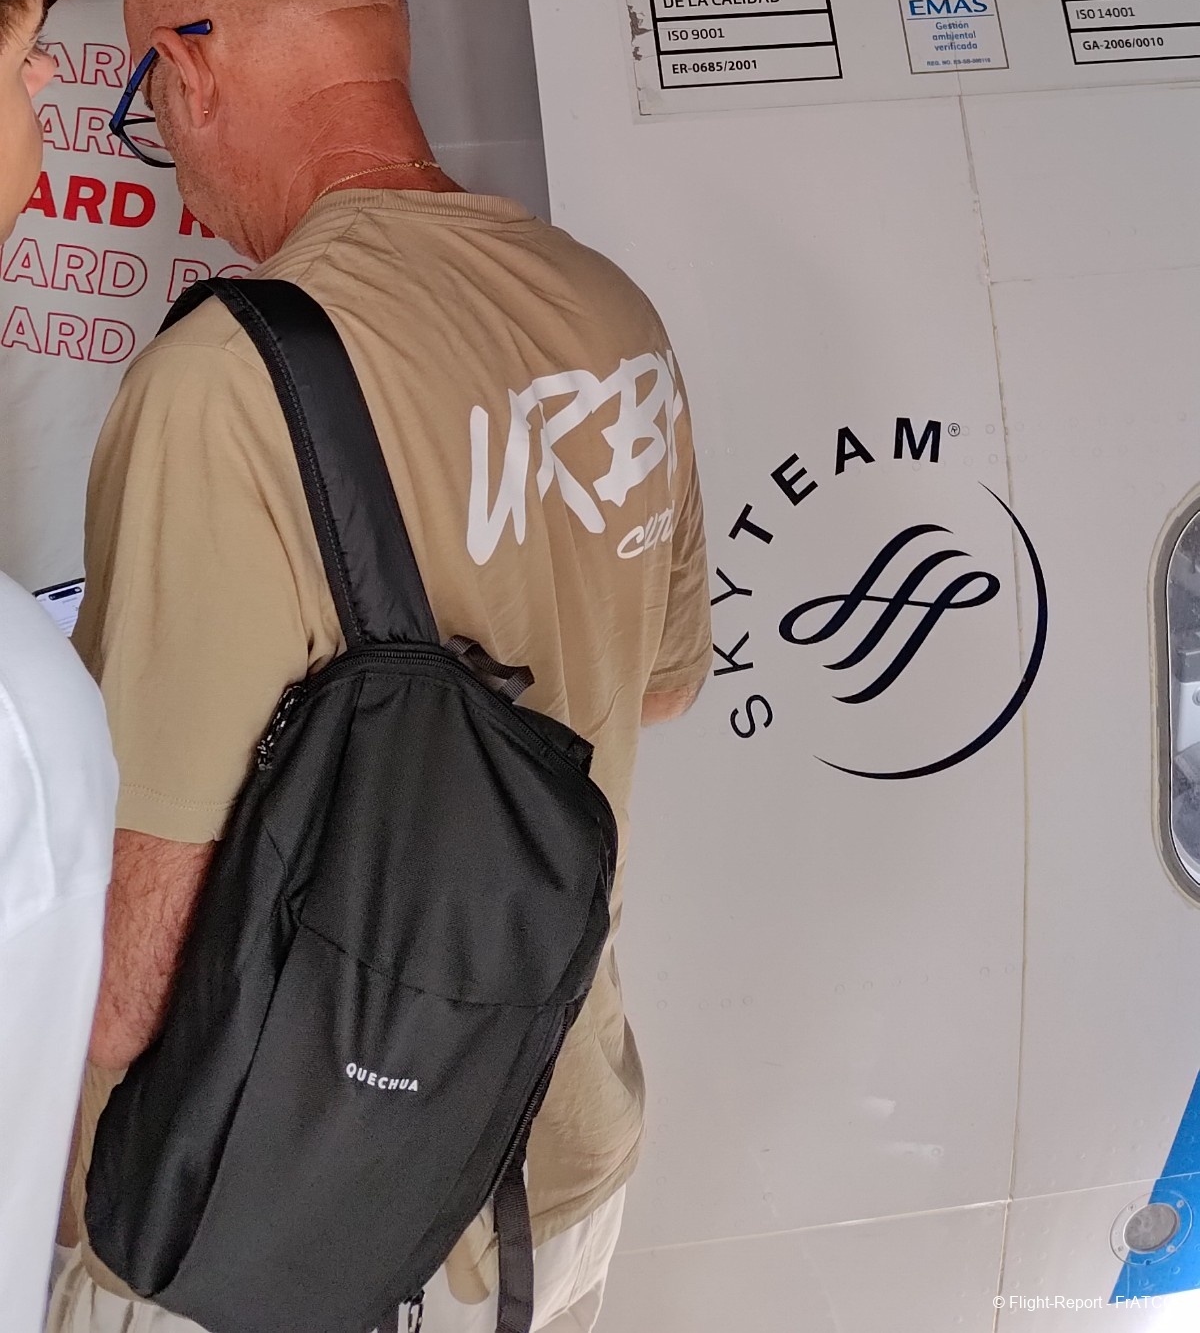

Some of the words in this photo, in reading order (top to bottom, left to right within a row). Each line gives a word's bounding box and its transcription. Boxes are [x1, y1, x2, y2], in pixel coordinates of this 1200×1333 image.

[1076, 8, 1096, 20] ISO
[1097, 7, 1136, 19] 14001
[667, 30, 689, 41] ISO
[692, 28, 725, 40] 9001
[1082, 36, 1164, 51] GA-2006/0010
[671, 60, 758, 75] ER-0685/2001
[21, 171, 156, 228] ARD
[0, 238, 148, 298] ARD
[1, 306, 136, 364] ARD
[345, 1062, 418, 1092] QUECHUA
